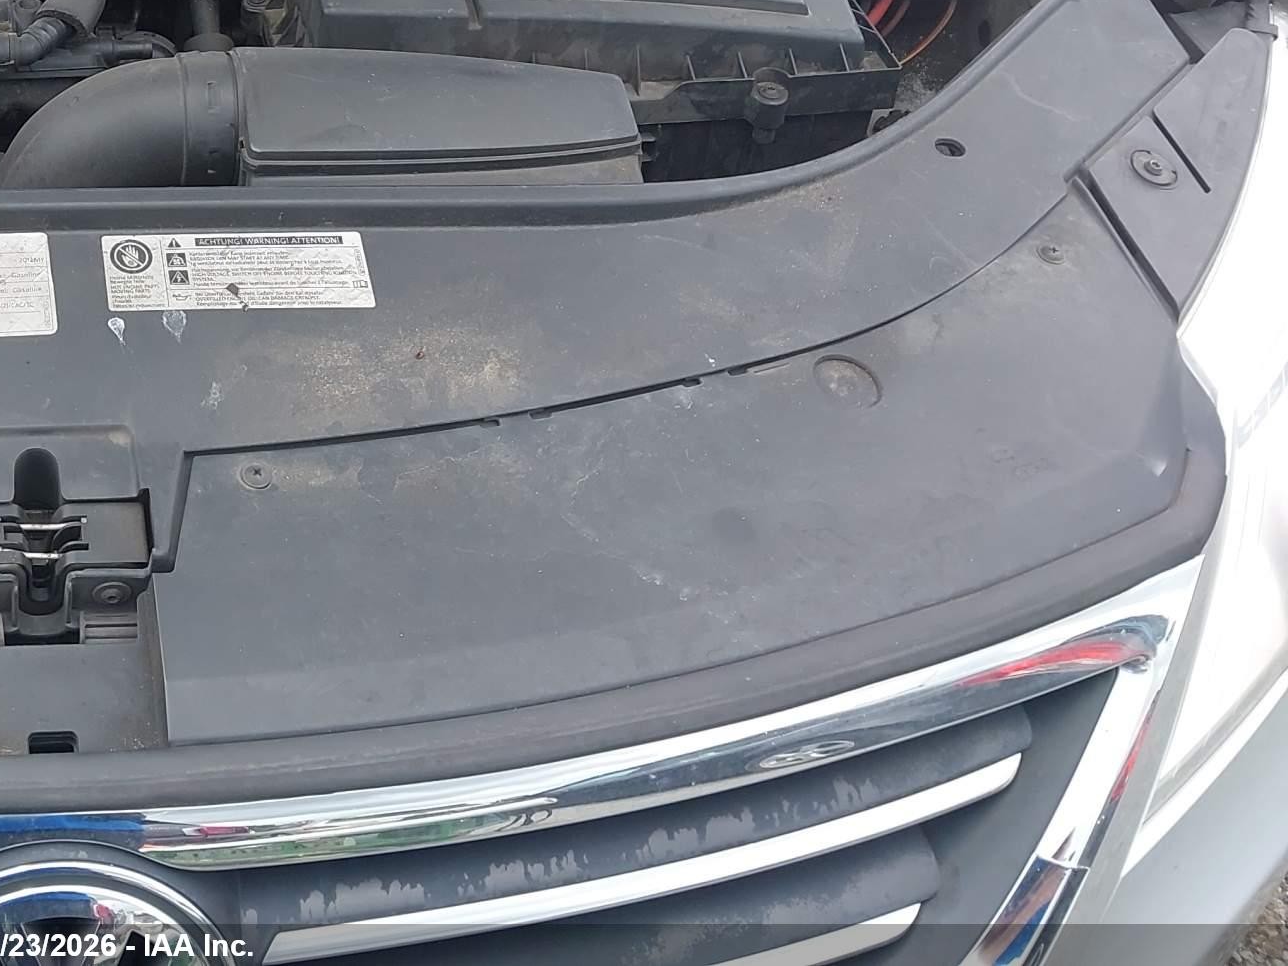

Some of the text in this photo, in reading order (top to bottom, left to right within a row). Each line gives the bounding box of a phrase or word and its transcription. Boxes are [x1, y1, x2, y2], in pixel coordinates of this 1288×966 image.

[199, 236, 341, 246] ACHTUNG! WARNING! ATTENTION!
